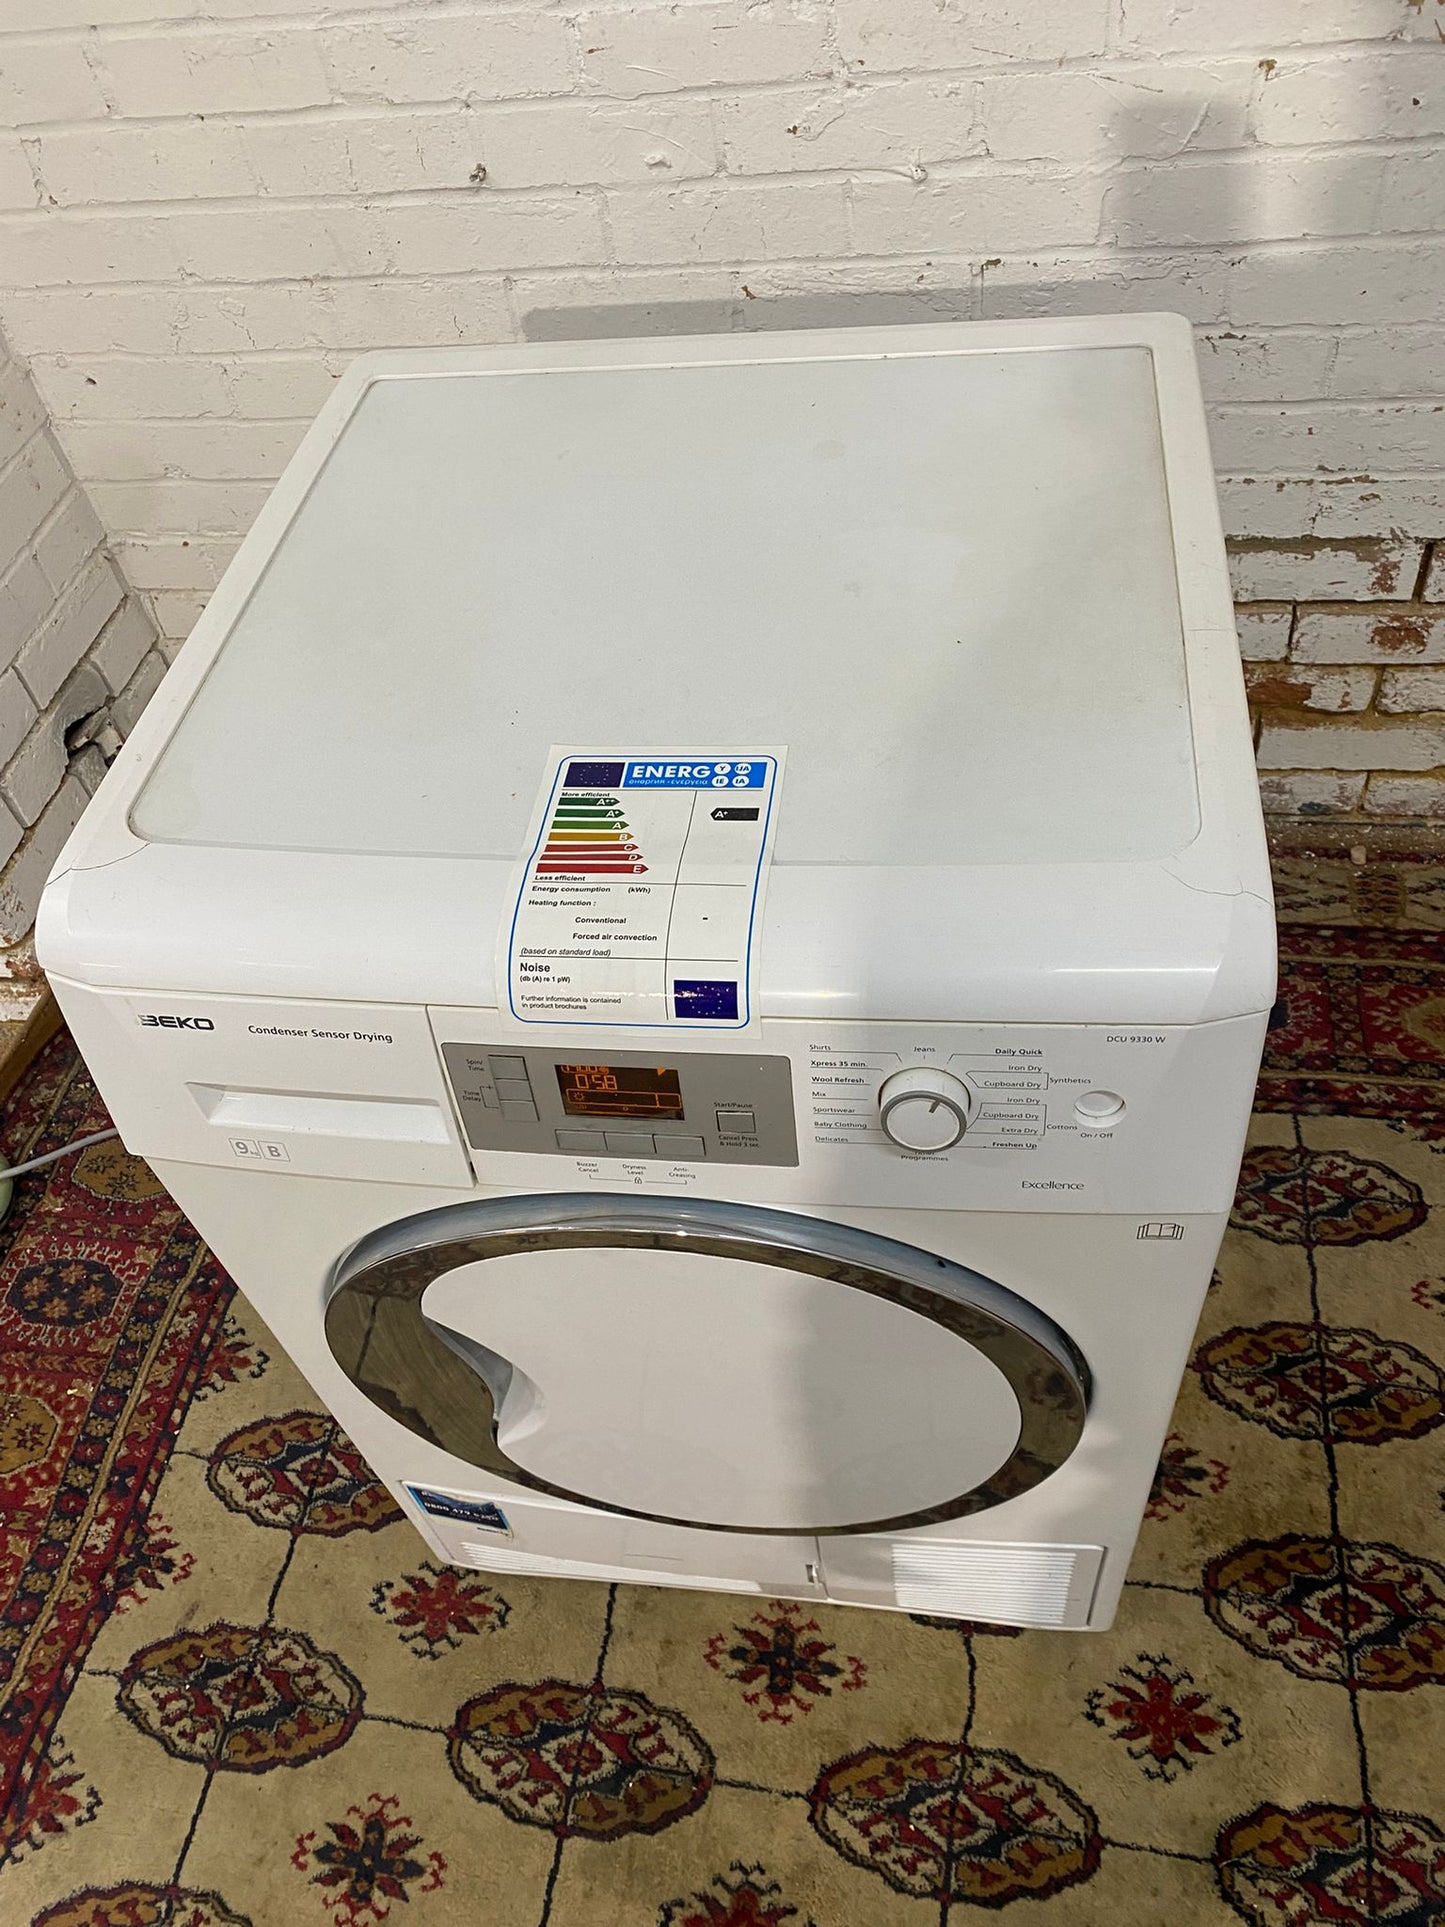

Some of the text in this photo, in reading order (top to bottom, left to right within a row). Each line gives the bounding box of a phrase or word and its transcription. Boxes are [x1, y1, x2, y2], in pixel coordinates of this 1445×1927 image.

[632, 766, 711, 778] ENERG
[612, 822, 622, 830] A
[619, 833, 628, 841] B
[633, 865, 642, 873] E
[628, 886, 651, 894] (kWh)
[529, 900, 557, 908] Heating
[521, 947, 546, 955] (based
[592, 949, 611, 957] load)
[520, 962, 550, 972] Noise
[138, 1014, 215, 1030] BEKO
[248, 1025, 393, 1044] Condenser Sensor Drying
[995, 1048, 1016, 1056] Daily
[810, 1060, 837, 1068] Xpress
[1050, 1077, 1091, 1086] Synthetics
[983, 1112, 1023, 1120] Cupboard
[235, 1142, 249, 1154] 9
[267, 1145, 281, 1157] B
[1021, 1180, 1084, 1190] Excellence
